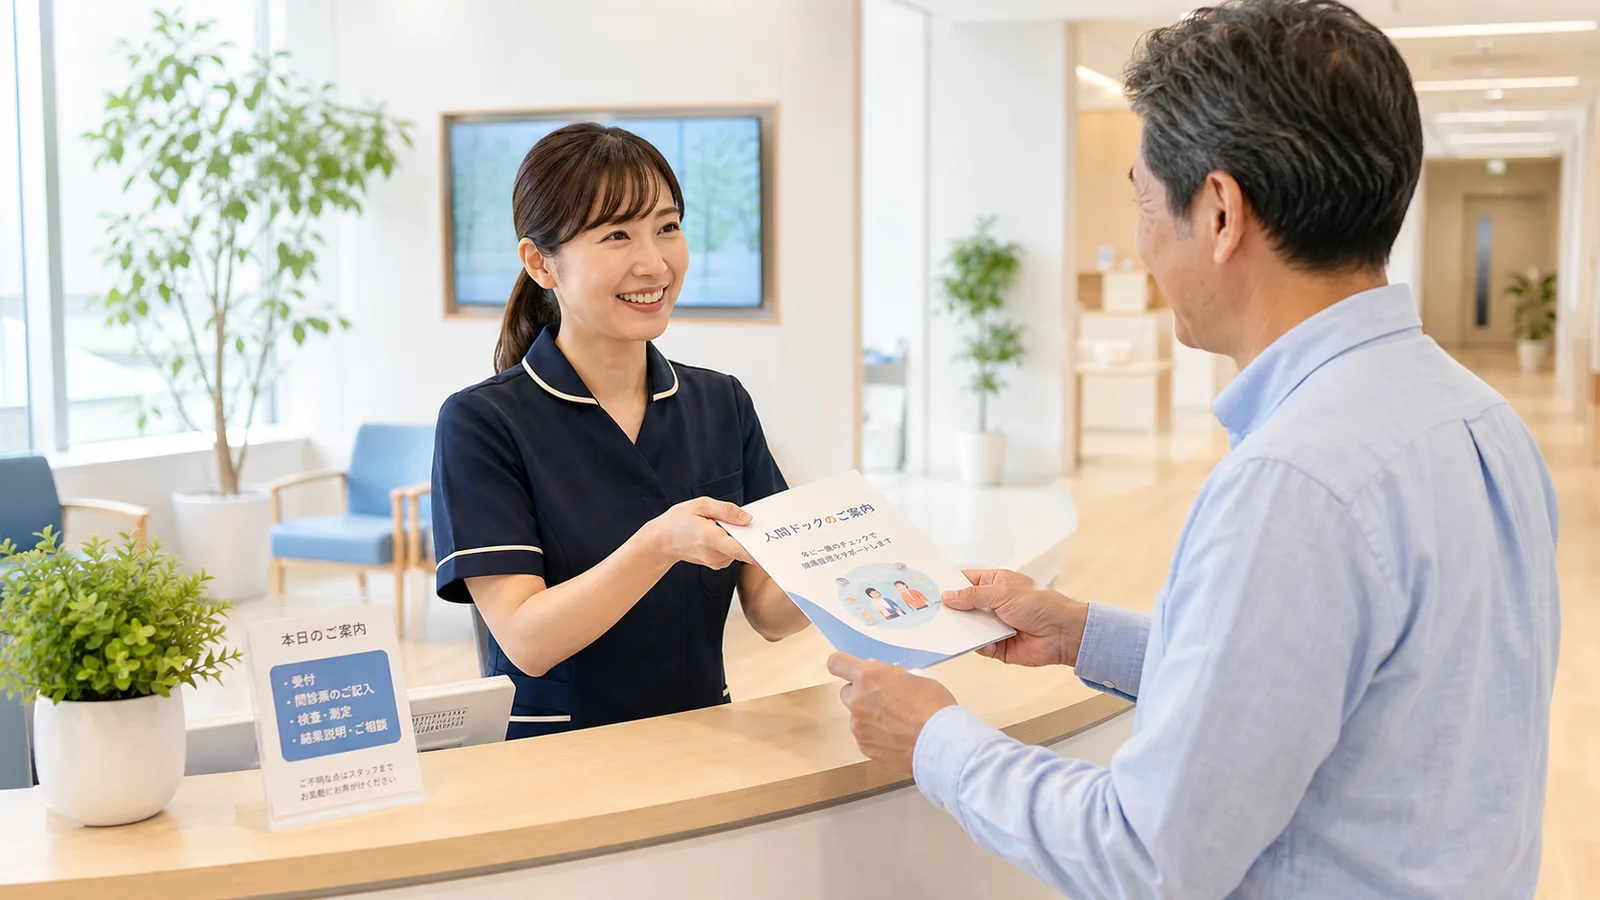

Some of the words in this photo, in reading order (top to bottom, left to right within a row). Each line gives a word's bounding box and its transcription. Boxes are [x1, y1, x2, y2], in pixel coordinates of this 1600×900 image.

[764, 502, 875, 542] 人間ドックのご案内
[281, 622, 367, 647] 本日のご案内
